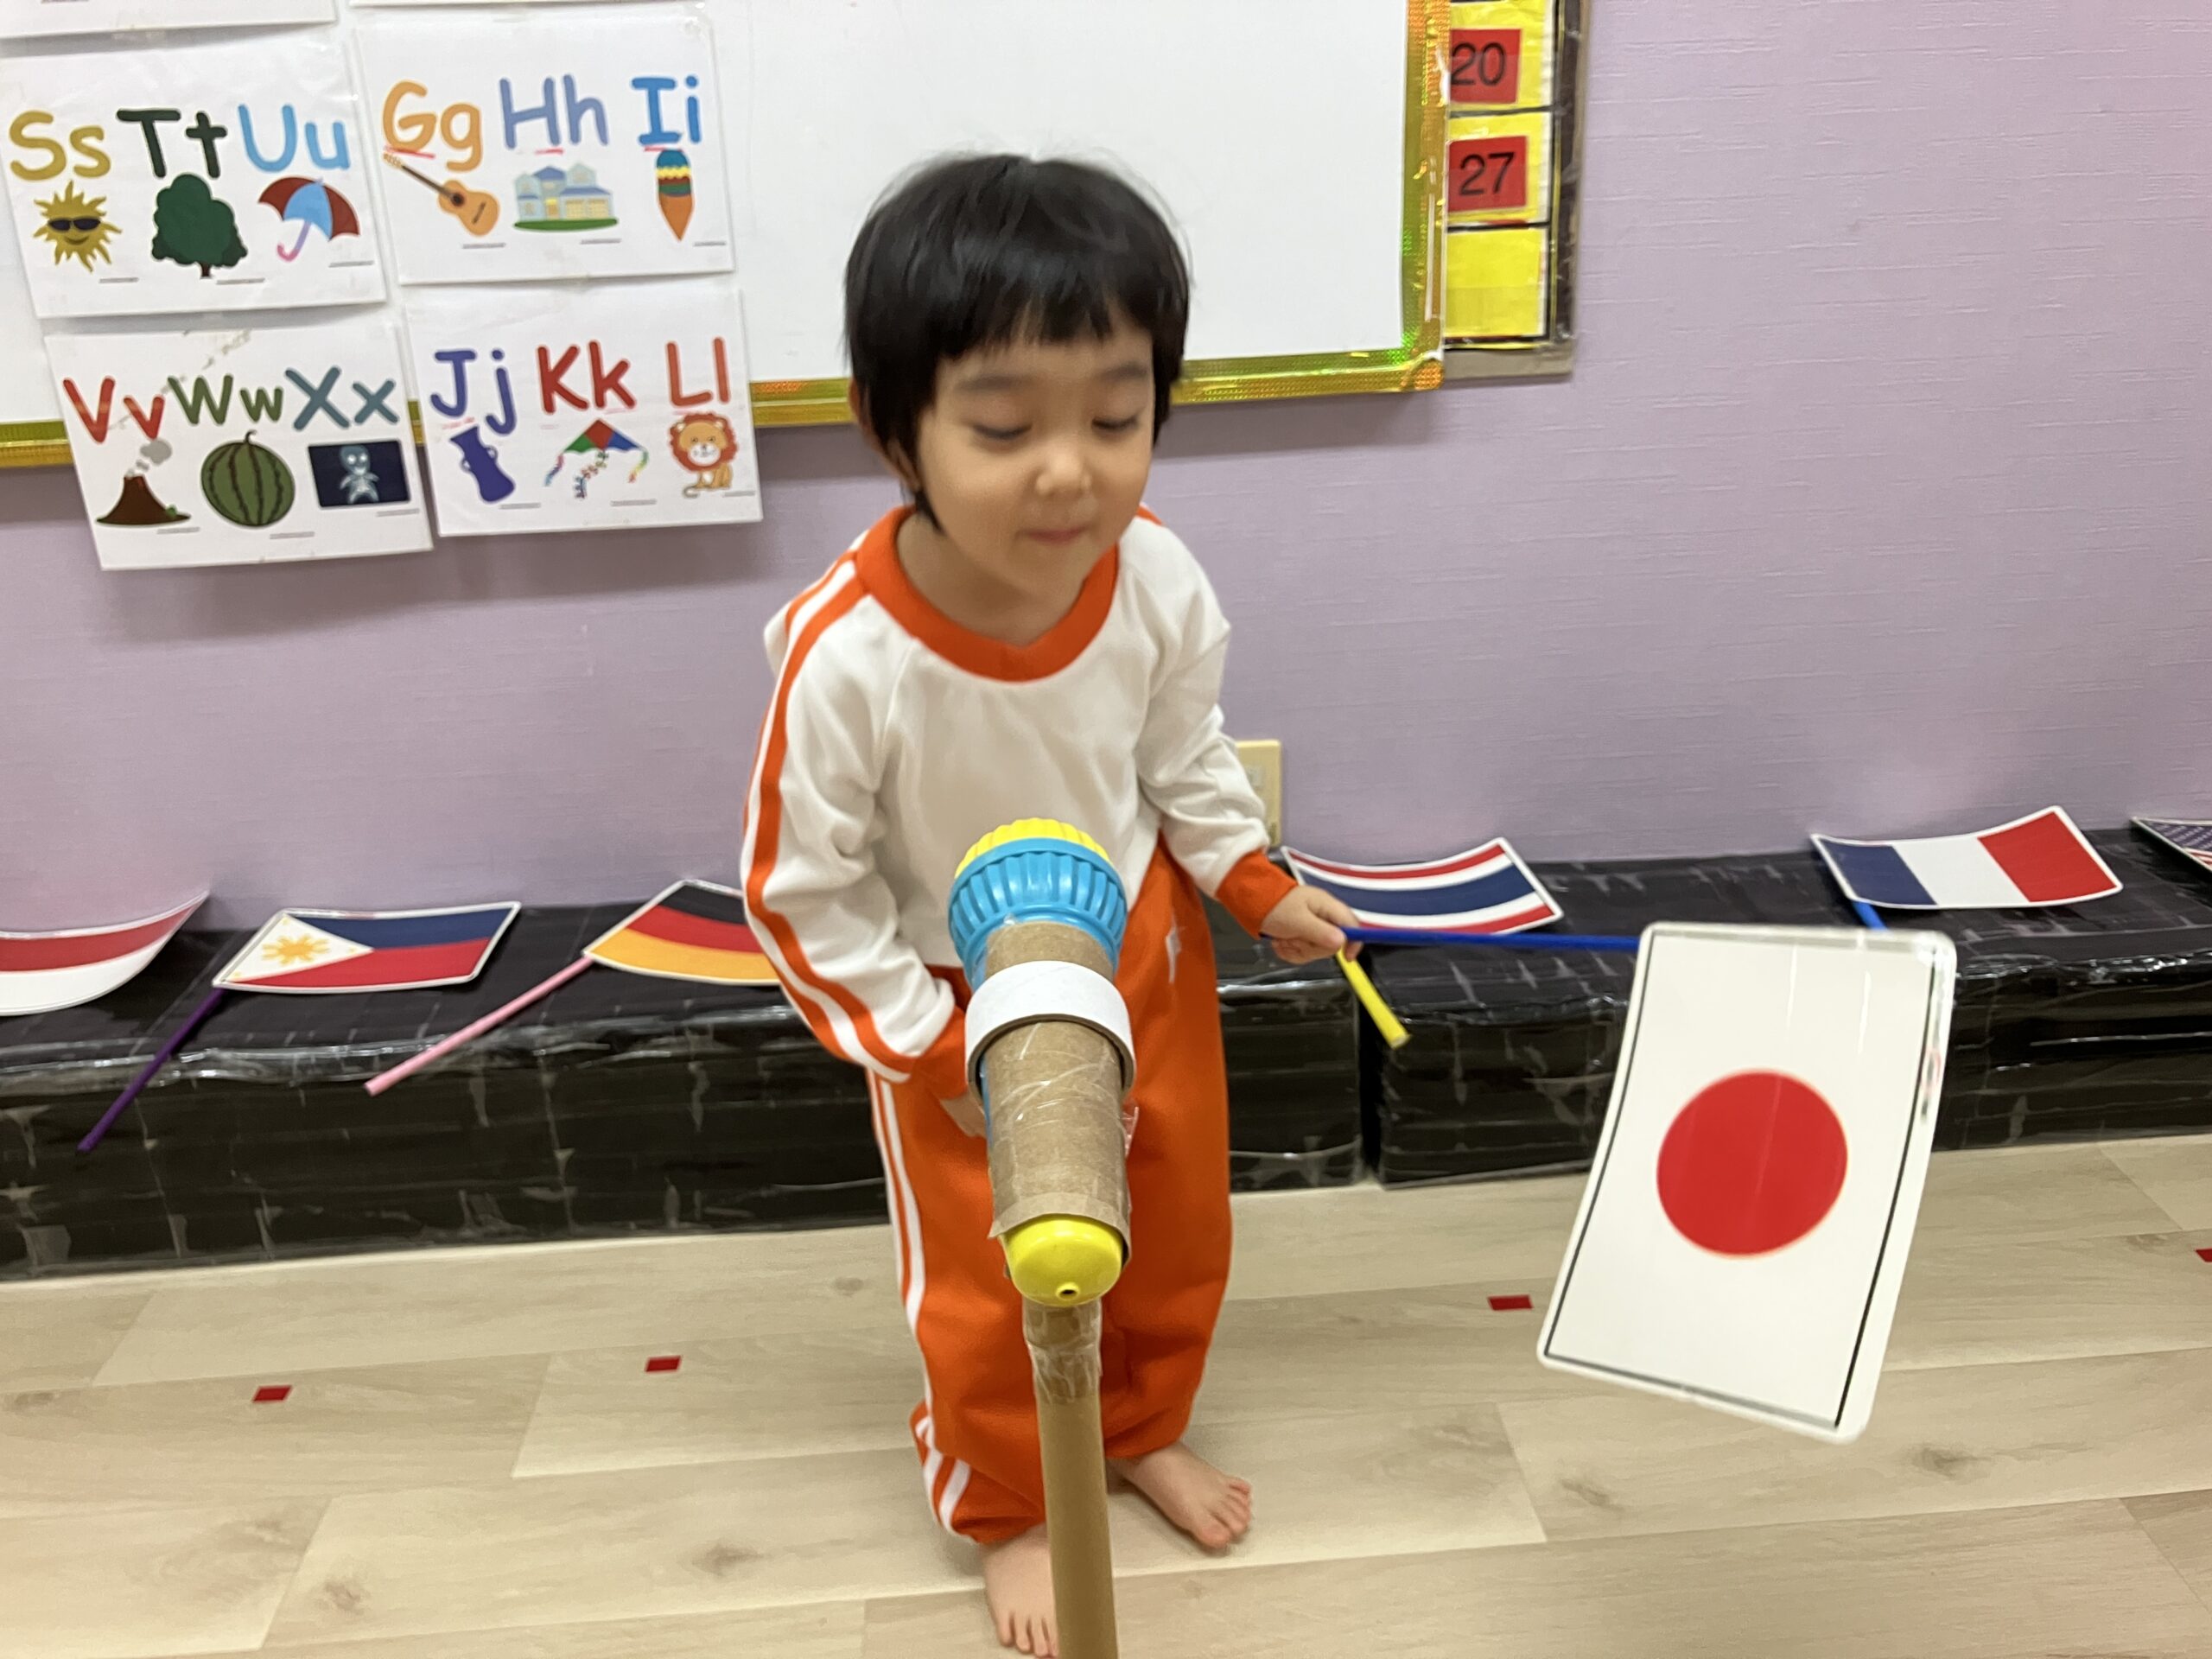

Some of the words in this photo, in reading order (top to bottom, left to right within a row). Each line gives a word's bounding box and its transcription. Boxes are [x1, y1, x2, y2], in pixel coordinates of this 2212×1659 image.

[1450, 42, 1506, 86] 20
[8, 109, 111, 181] Ss
[116, 107, 228, 179] Tt
[238, 104, 351, 173] Uu
[383, 79, 483, 173] Gg
[499, 73, 610, 149] Hh
[630, 74, 702, 144] Ii
[1458, 151, 1515, 196] 27
[62, 375, 165, 443] Vv
[167, 373, 284, 425] Ww
[284, 365, 399, 431] Xx
[430, 348, 518, 436] Jj
[537, 340, 637, 414] Kk
